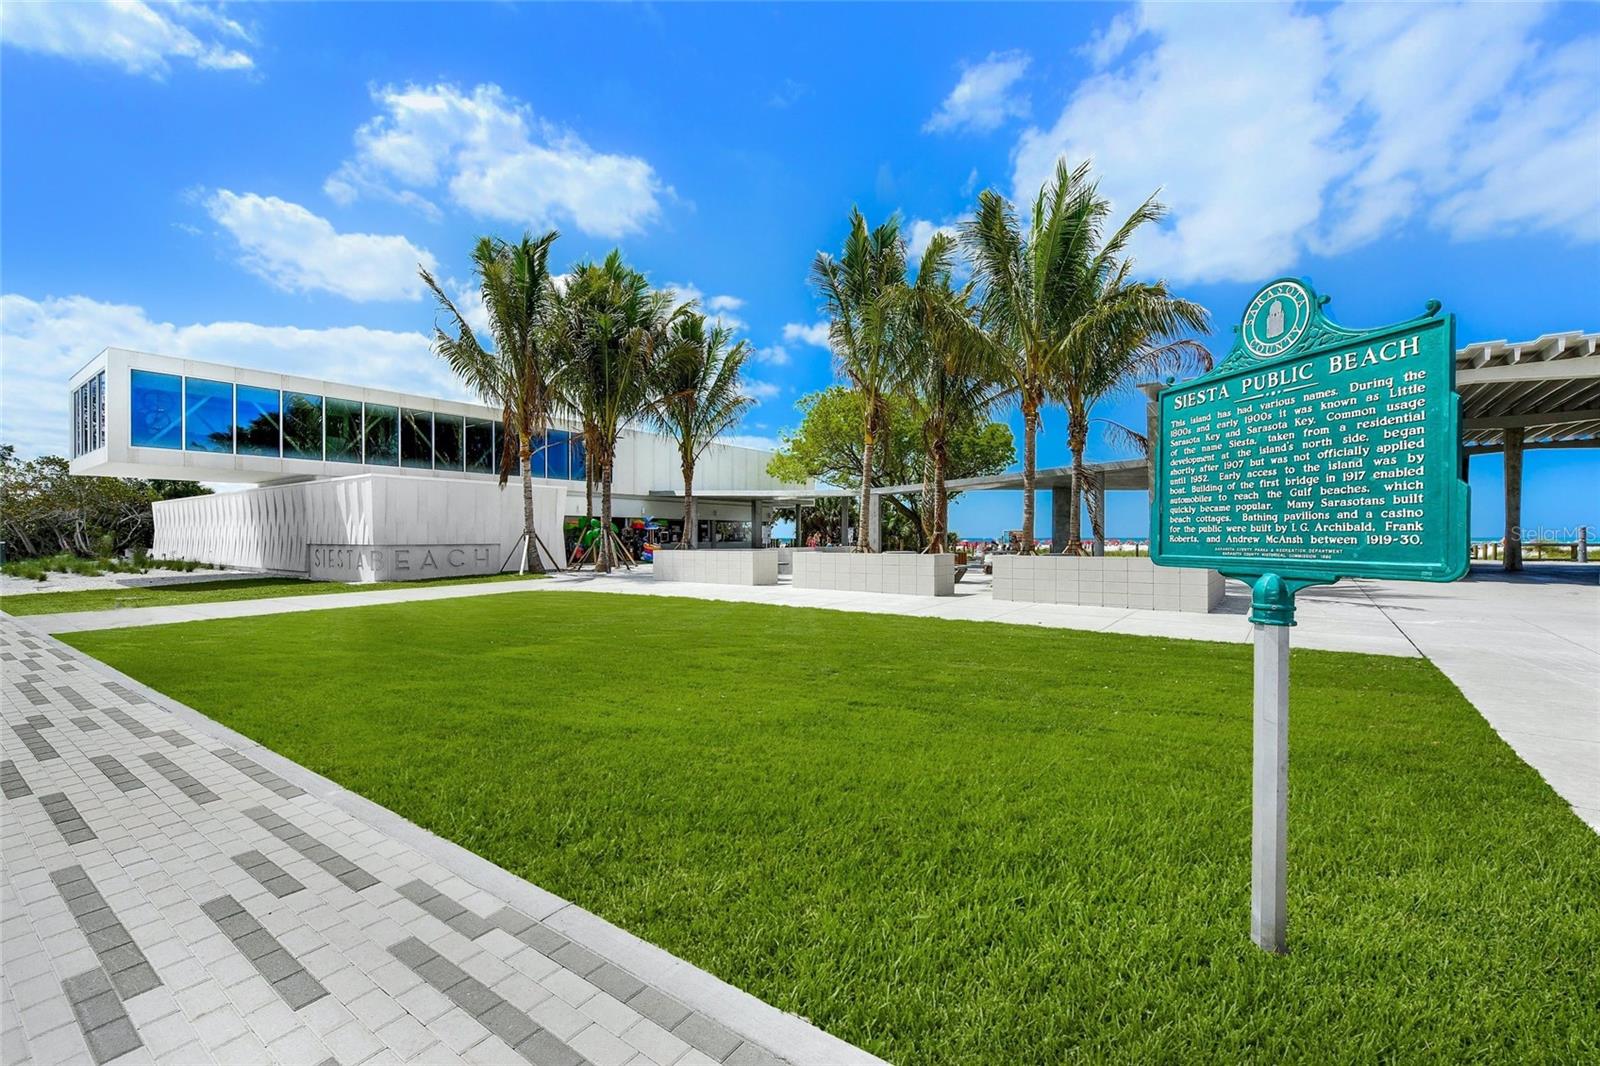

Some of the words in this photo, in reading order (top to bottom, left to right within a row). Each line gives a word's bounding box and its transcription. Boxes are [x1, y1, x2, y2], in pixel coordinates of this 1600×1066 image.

[1246, 286, 1306, 325] SARASOTA
[1250, 326, 1300, 354] COUNTY
[1174, 384, 1229, 410] SIESTA
[1242, 363, 1312, 394] PUBLIC
[1329, 336, 1419, 374] BEACH
[1171, 428, 1191, 437] 1800s
[1217, 419, 1238, 428] early
[1245, 413, 1272, 424] 1900s
[1295, 406, 1312, 414] was
[1321, 397, 1357, 410] known
[1366, 394, 1379, 402] as
[1390, 385, 1425, 398] Little
[1191, 414, 1211, 424] island
[1217, 410, 1231, 418] has
[1237, 405, 1252, 414] had
[1260, 397, 1295, 410] various
[1303, 389, 1338, 401] names.
[1350, 378, 1393, 392] During
[1404, 370, 1426, 381] the
[1170, 437, 1200, 447] Sarasota
[1205, 433, 1220, 442] Key
[1226, 429, 1240, 437] and
[1247, 421, 1287, 434] Sarasota
[1295, 417, 1315, 426] Key.
[1326, 407, 1376, 421] Common
[1387, 398, 1425, 411] usage
[1202, 444, 1222, 452] name
[1268, 432, 1294, 442] taken
[1303, 427, 1329, 437] from
[1357, 411, 1425, 429] residential
[1170, 454, 1214, 466] development
[1238, 449, 1251, 457] the
[1260, 442, 1293, 454] island's
[1303, 438, 1332, 448] north
[1384, 426, 1424, 438] began
[1170, 466, 1195, 476] shortly
[1200, 464, 1219, 472] after
[1224, 460, 1244, 470] 1907
[1250, 458, 1264, 466] but
[1271, 456, 1288, 464] was
[1294, 453, 1310, 461] not
[1317, 447, 1369, 459] officially
[1376, 438, 1424, 454] applied
[1170, 477, 1185, 485] until
[1191, 474, 1209, 483] 1952.
[1220, 472, 1240, 480] Early
[1247, 469, 1277, 477] access
[1303, 464, 1320, 472] the
[1328, 459, 1362, 470] island
[1373, 456, 1396, 465] was
[1408, 454, 1424, 463] by
[1227, 482, 1235, 490] of
[1240, 481, 1254, 489] the
[1260, 479, 1279, 487] first
[1285, 476, 1319, 485] bridge
[1326, 474, 1335, 482] in
[1343, 471, 1365, 481] 1917
[1373, 466, 1424, 478] enabled
[1170, 496, 1211, 504] automobiles
[1234, 491, 1259, 500] reach
[1267, 490, 1282, 498] the
[1290, 488, 1312, 497] Gulf
[1384, 480, 1424, 491] which
[1170, 506, 1196, 514] quickly
[1236, 502, 1273, 512] popular.
[1287, 500, 1314, 509] Many
[1321, 498, 1385, 507] Sarasotans
[1393, 494, 1424, 504] built
[1170, 515, 1190, 523] beach
[1196, 515, 1231, 523] cottages.
[1243, 513, 1278, 522] Bathing
[1284, 512, 1330, 522] pavilions
[1337, 510, 1358, 519] and
[1381, 509, 1423, 518] casino
[1199, 525, 1222, 533] public
[1276, 525, 1287, 533] by
[1300, 523, 1309, 532] G.
[1385, 521, 1424, 531] Frank
[1266, 535, 1303, 543] McAnsh
[1311, 535, 1357, 544] between
[1367, 535, 1423, 544] 1919-30.
[314, 549, 363, 570] SIESTA
[371, 548, 489, 571] BEACH
